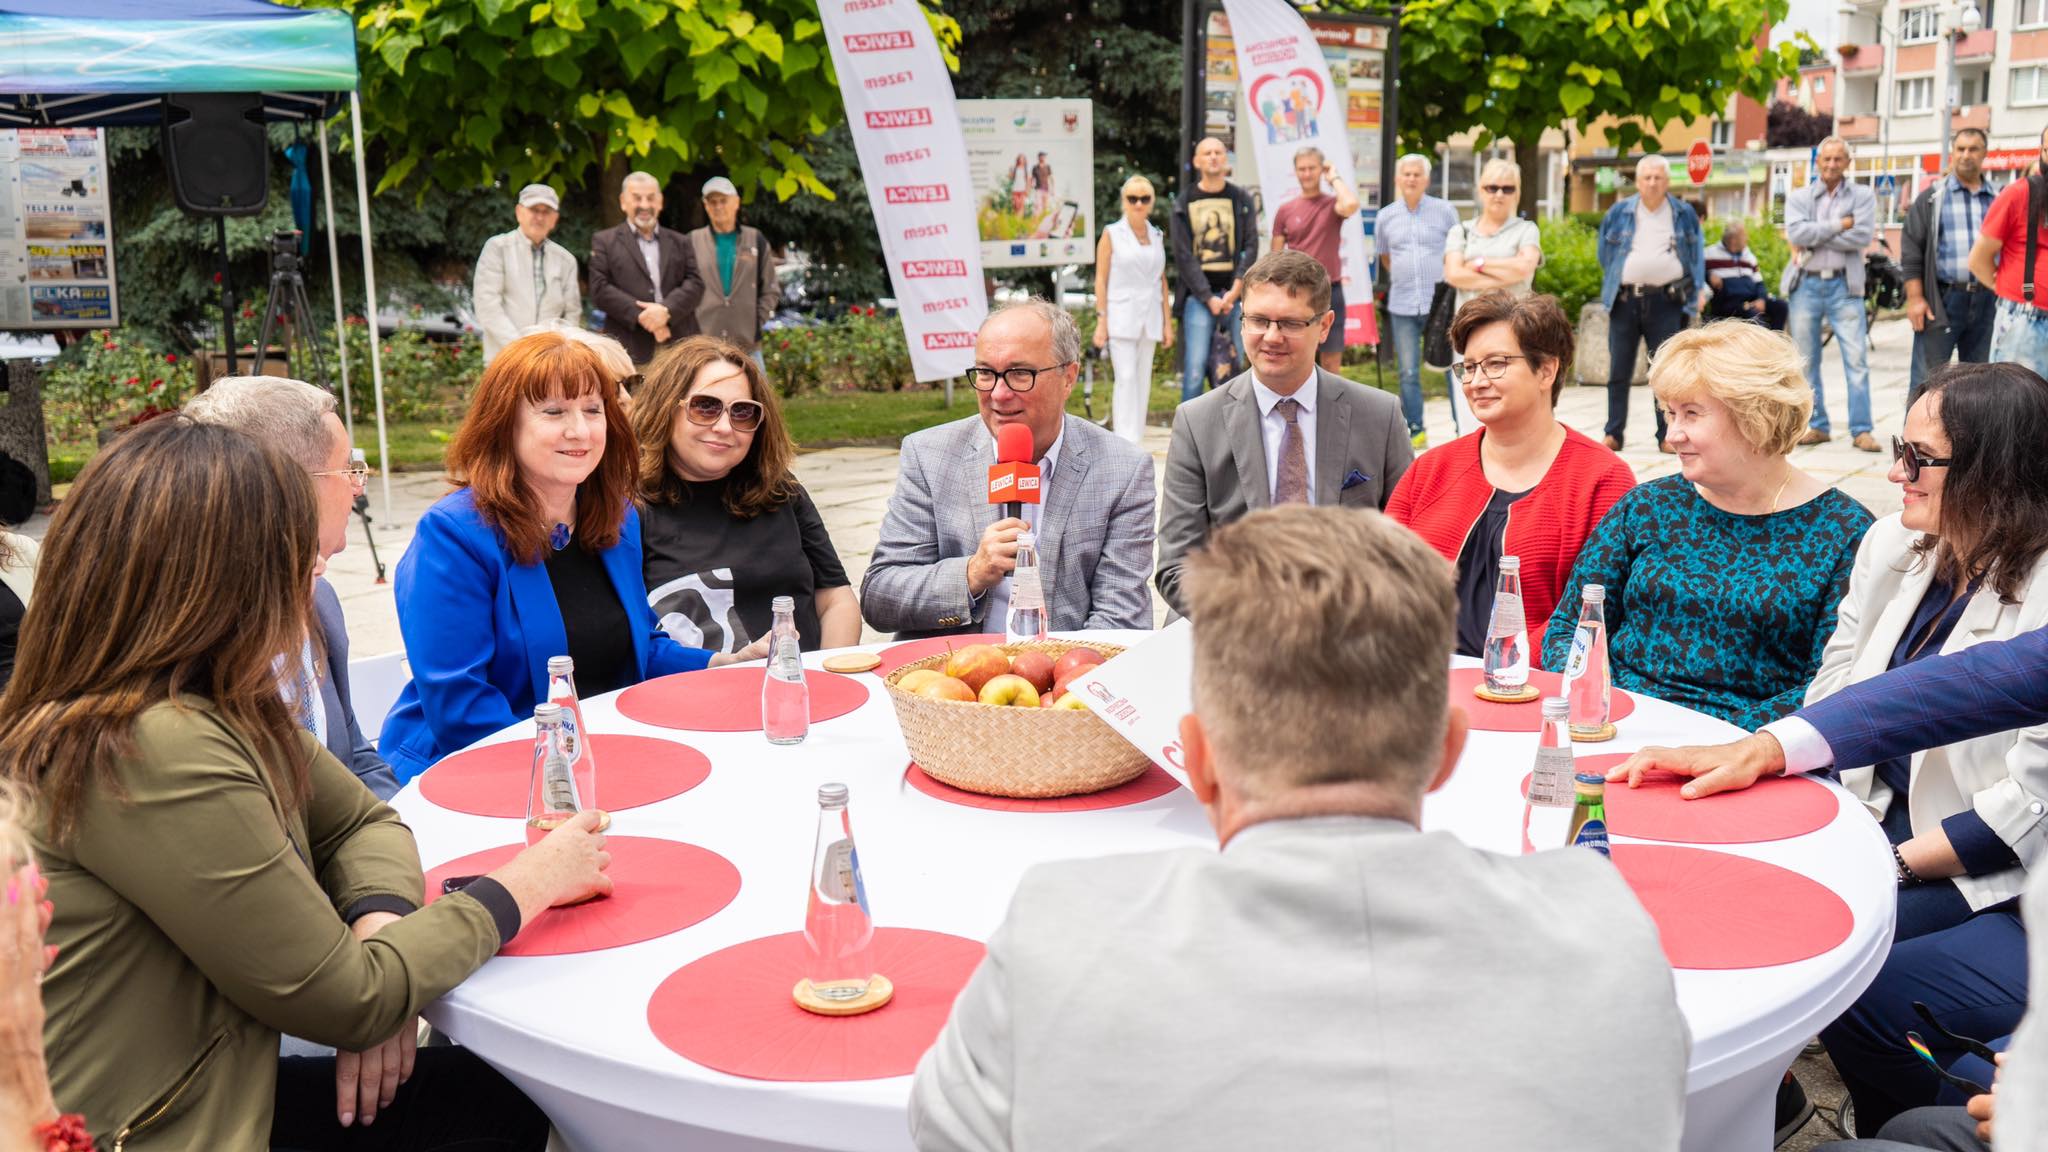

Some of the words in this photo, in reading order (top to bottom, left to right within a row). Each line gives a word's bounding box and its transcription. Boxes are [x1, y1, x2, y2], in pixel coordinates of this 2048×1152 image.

[1689, 154, 1709, 170] STOP
[33, 287, 80, 299] ELKA
[992, 475, 1012, 490] LEWICA
[1020, 478, 1037, 488] LEWICA
